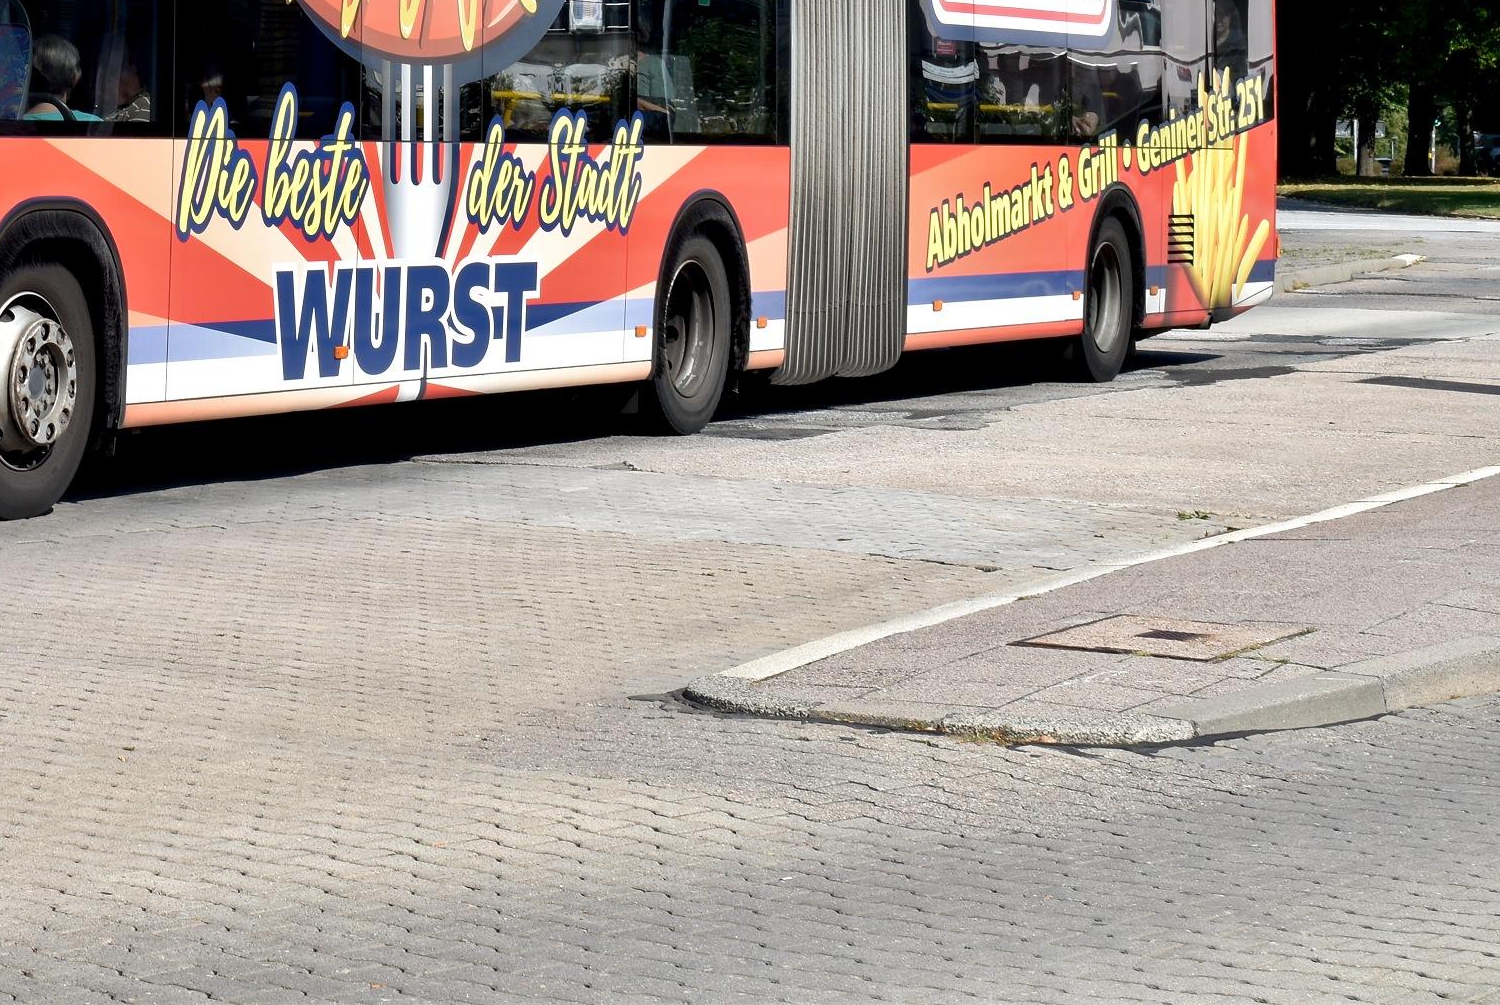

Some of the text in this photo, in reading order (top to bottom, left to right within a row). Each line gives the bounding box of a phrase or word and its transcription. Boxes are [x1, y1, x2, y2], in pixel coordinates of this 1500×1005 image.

[177, 86, 643, 239] Die beste der Stadt
[926, 75, 1264, 272] Abholmarkt & Grill Geniner Str. 251
[276, 261, 538, 381] WURST
